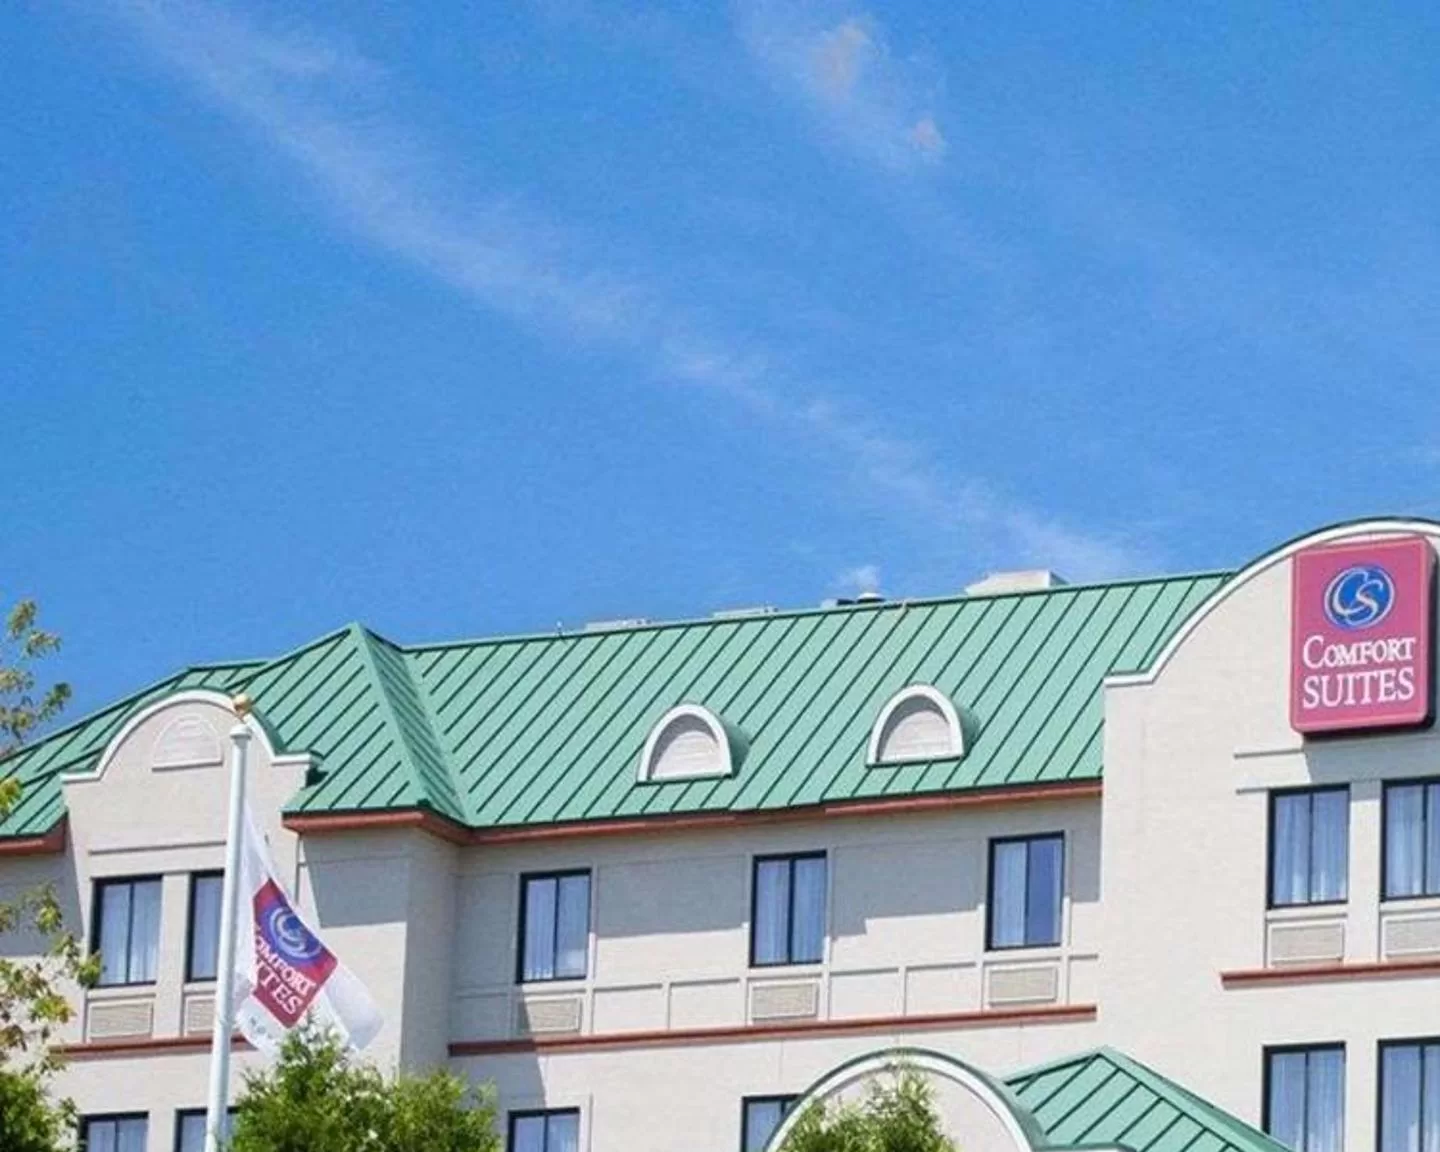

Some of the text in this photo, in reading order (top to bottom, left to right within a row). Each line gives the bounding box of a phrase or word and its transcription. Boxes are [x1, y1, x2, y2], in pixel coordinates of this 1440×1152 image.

[1303, 635, 1416, 669] COMFORT
[1303, 667, 1415, 708] SUITES
[256, 930, 317, 996] OMFORT
[256, 958, 304, 1014] ITES
